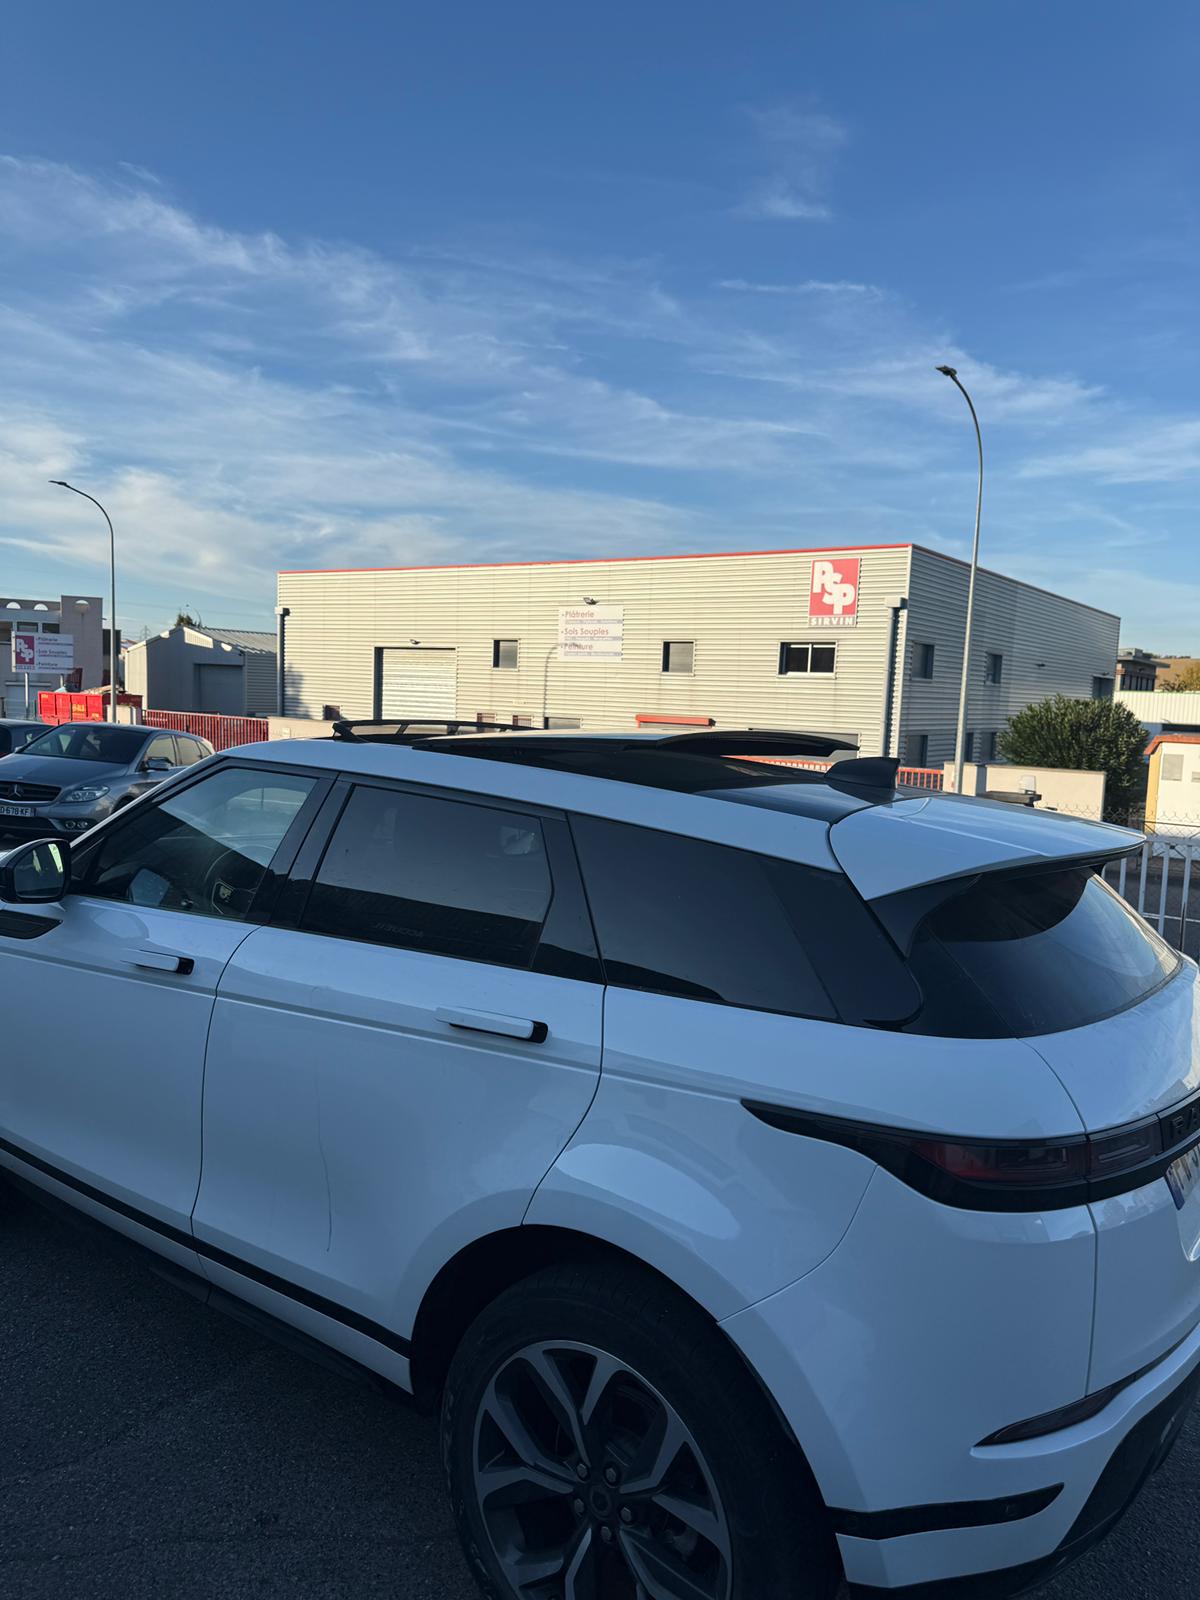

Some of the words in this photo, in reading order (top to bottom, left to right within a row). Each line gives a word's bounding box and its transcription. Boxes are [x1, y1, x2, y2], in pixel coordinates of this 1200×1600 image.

[810, 616, 855, 626] SIRVIN
[564, 627, 578, 636] Sols
[580, 627, 609, 637] Souples
